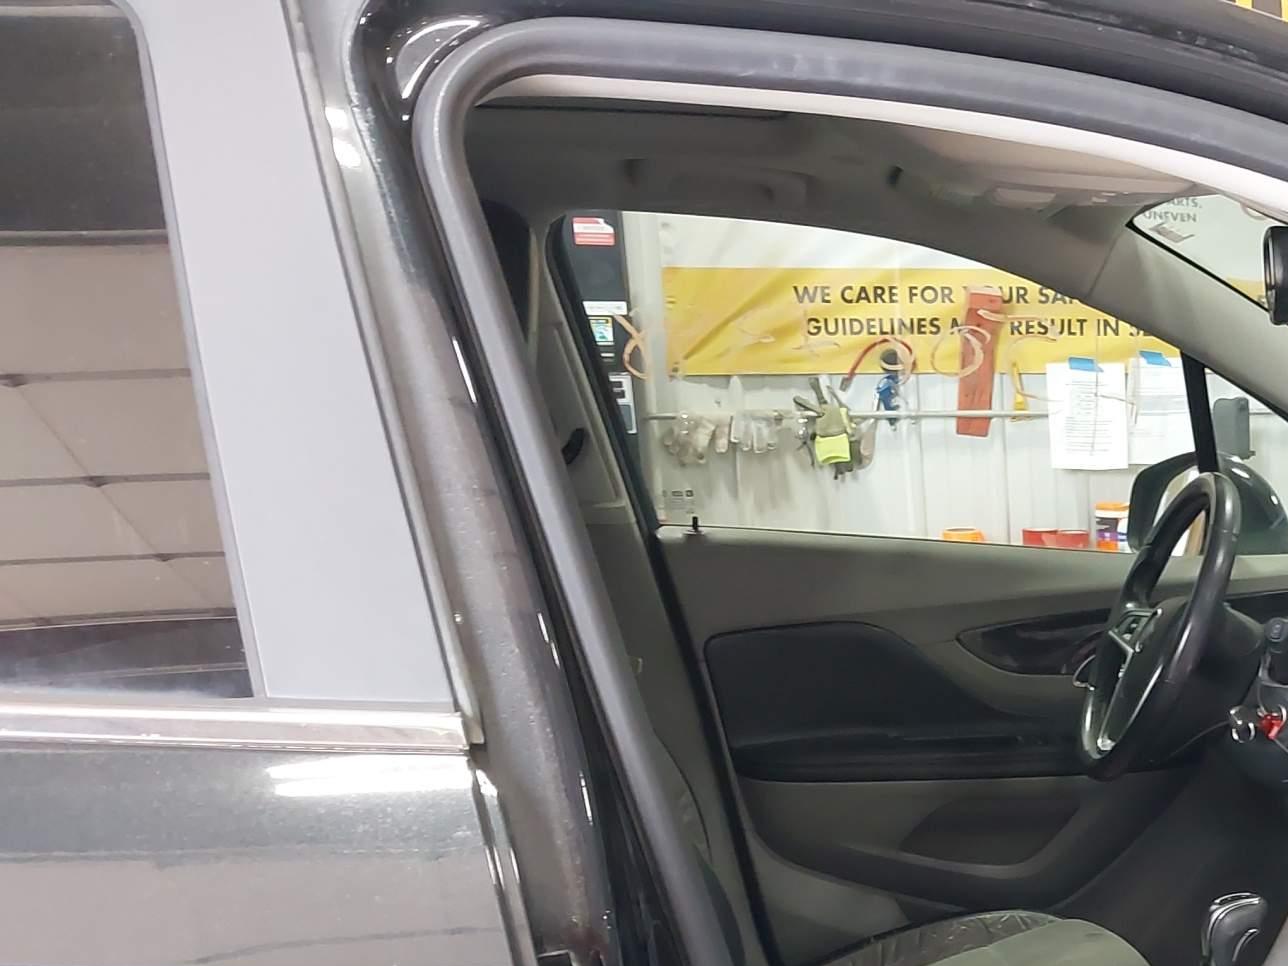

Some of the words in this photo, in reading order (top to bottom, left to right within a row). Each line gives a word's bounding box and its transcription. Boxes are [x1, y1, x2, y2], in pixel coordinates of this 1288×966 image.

[793, 285, 832, 304] WE
[840, 285, 899, 304] CARE
[908, 285, 955, 304] FOR
[807, 317, 941, 336] GUIDELINES
[1010, 318, 1087, 336] RESULT
[1097, 319, 1119, 337] IN
